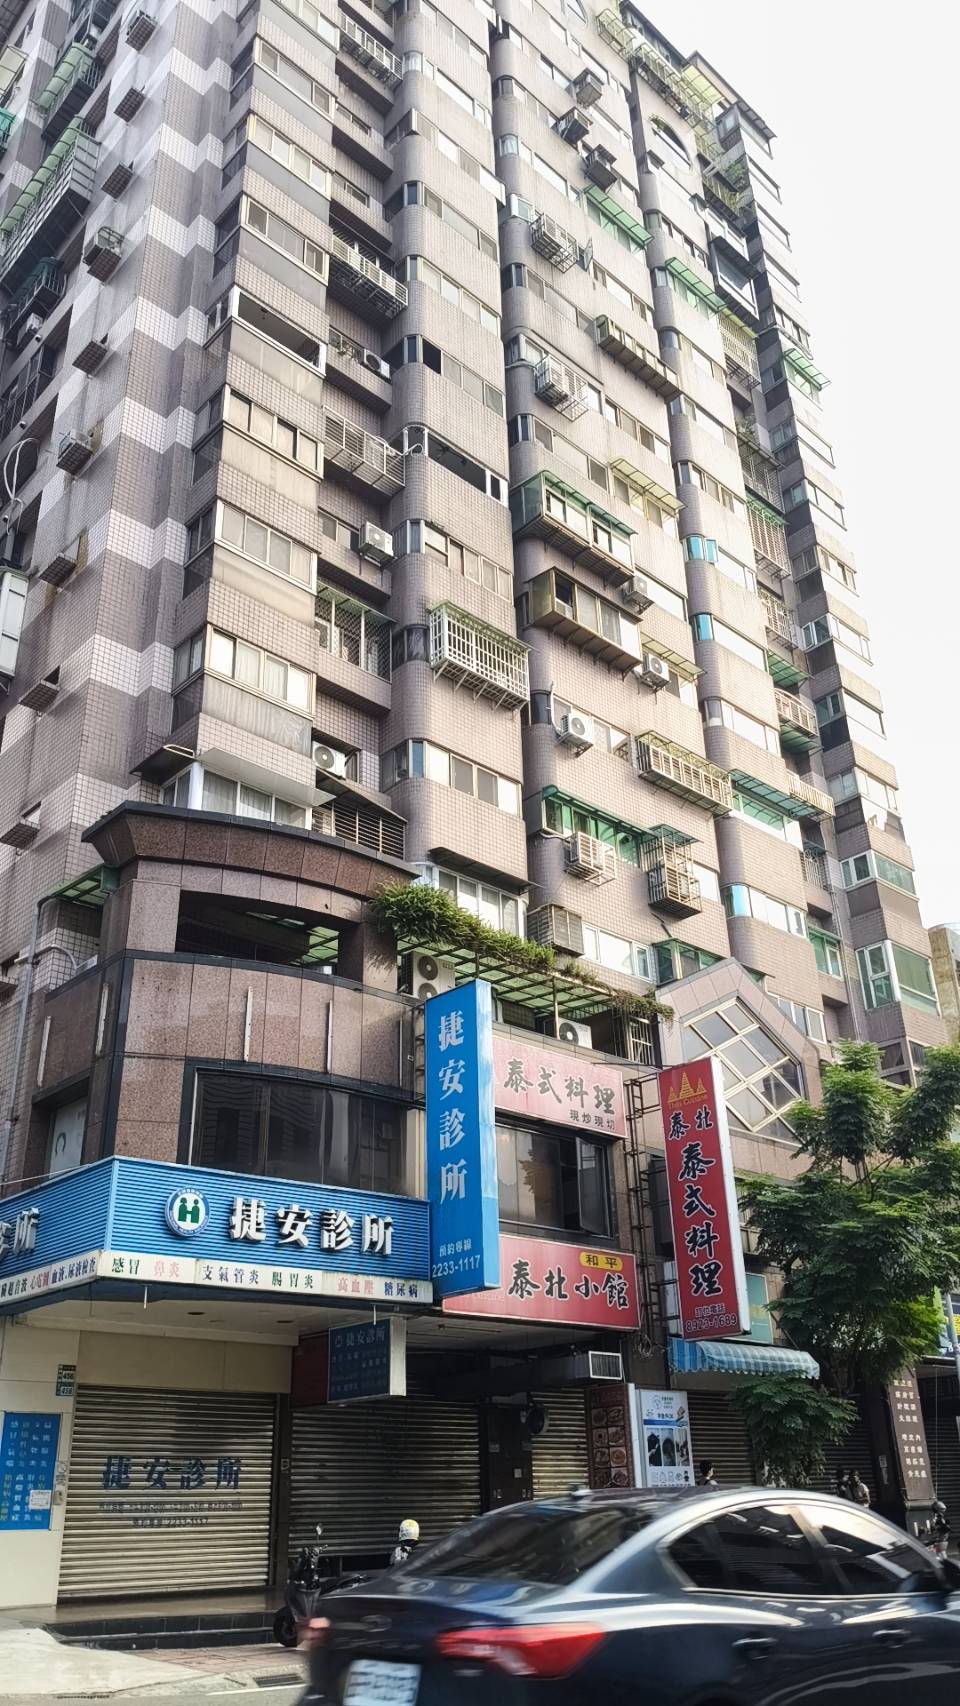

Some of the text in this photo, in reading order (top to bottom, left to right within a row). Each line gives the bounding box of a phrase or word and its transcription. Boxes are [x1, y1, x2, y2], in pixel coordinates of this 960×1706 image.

[438, 1009, 468, 1205] 捷安診所
[503, 1058, 616, 1115] 泰式料理
[669, 1104, 713, 1140] 泰北
[229, 1195, 395, 1256] 捷安診所
[678, 1141, 723, 1297] 泰式料理
[111, 1257, 140, 1275] 感冒
[202, 1264, 260, 1285] 支氣管炎
[272, 1271, 314, 1290] 腸胃炎
[384, 1280, 419, 1299] 糖尿病
[431, 1254, 481, 1278] 2233-1117
[507, 1258, 629, 1309] 泰北小館
[585, 1253, 618, 1269] 和平
[103, 1455, 242, 1490] 捷安診所
